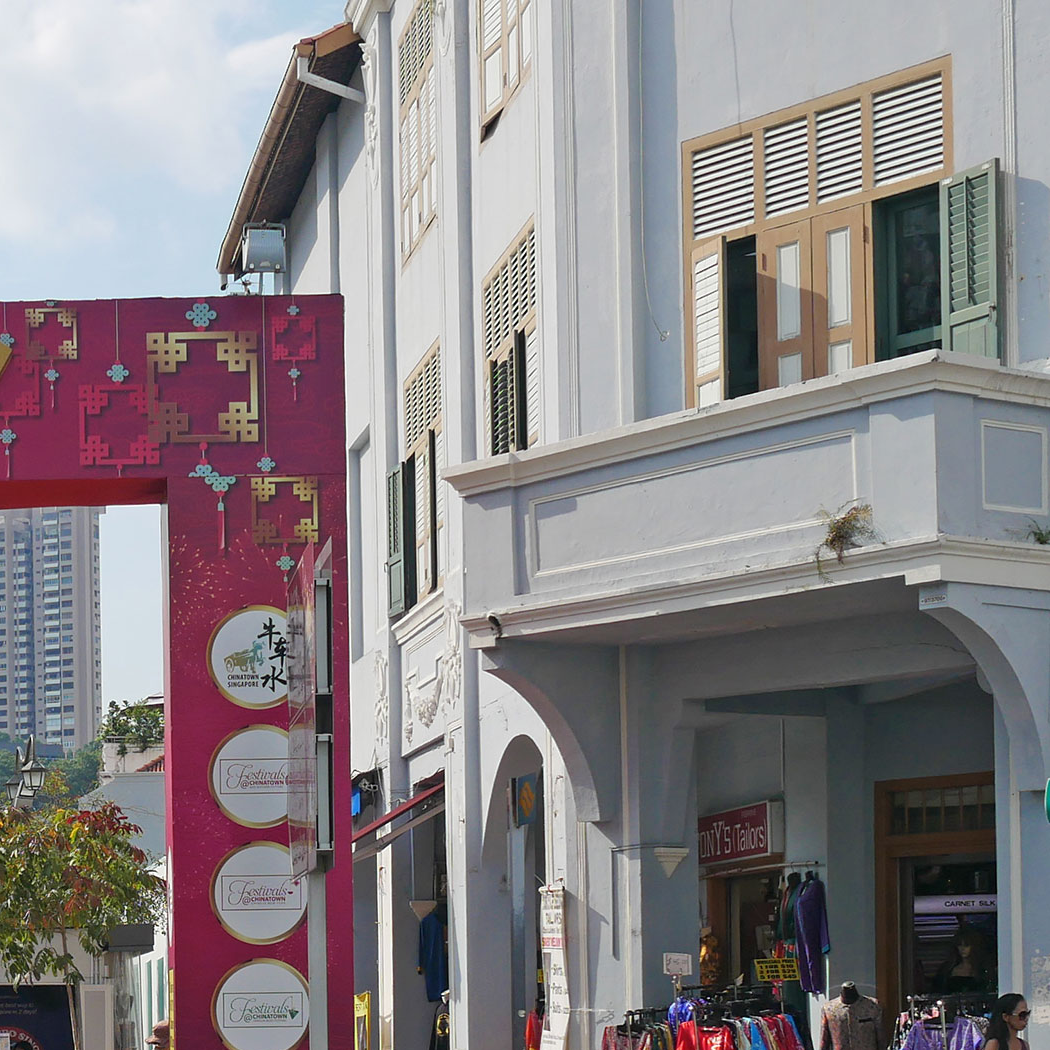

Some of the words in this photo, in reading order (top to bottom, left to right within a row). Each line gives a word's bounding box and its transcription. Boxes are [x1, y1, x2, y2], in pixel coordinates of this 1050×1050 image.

[226, 762, 286, 789] Festivals
[228, 879, 288, 906] Festivals
[229, 996, 290, 1023] Festivals
